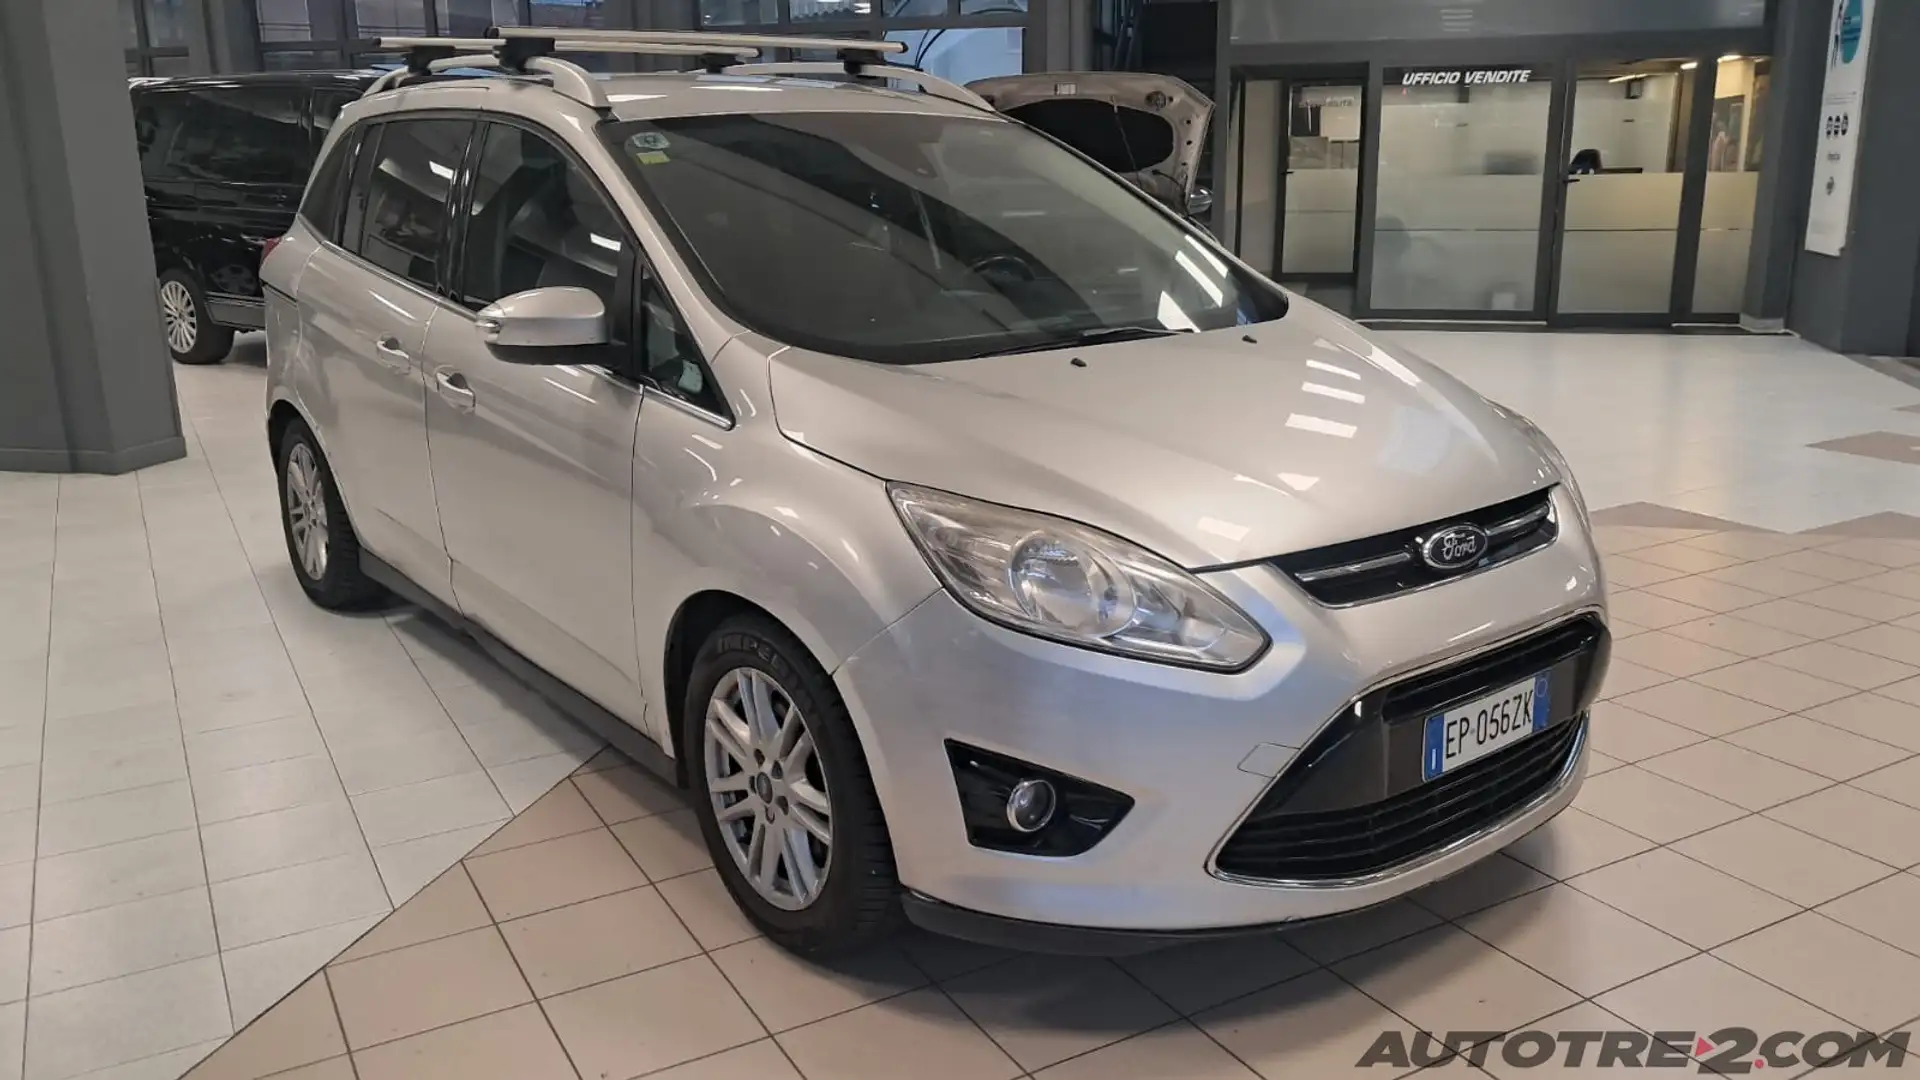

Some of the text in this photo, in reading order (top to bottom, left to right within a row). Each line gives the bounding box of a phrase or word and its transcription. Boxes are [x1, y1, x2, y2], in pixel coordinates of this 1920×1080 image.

[1402, 69, 1532, 85] UFFICIO VENDITE
[1441, 532, 1477, 560] Ford
